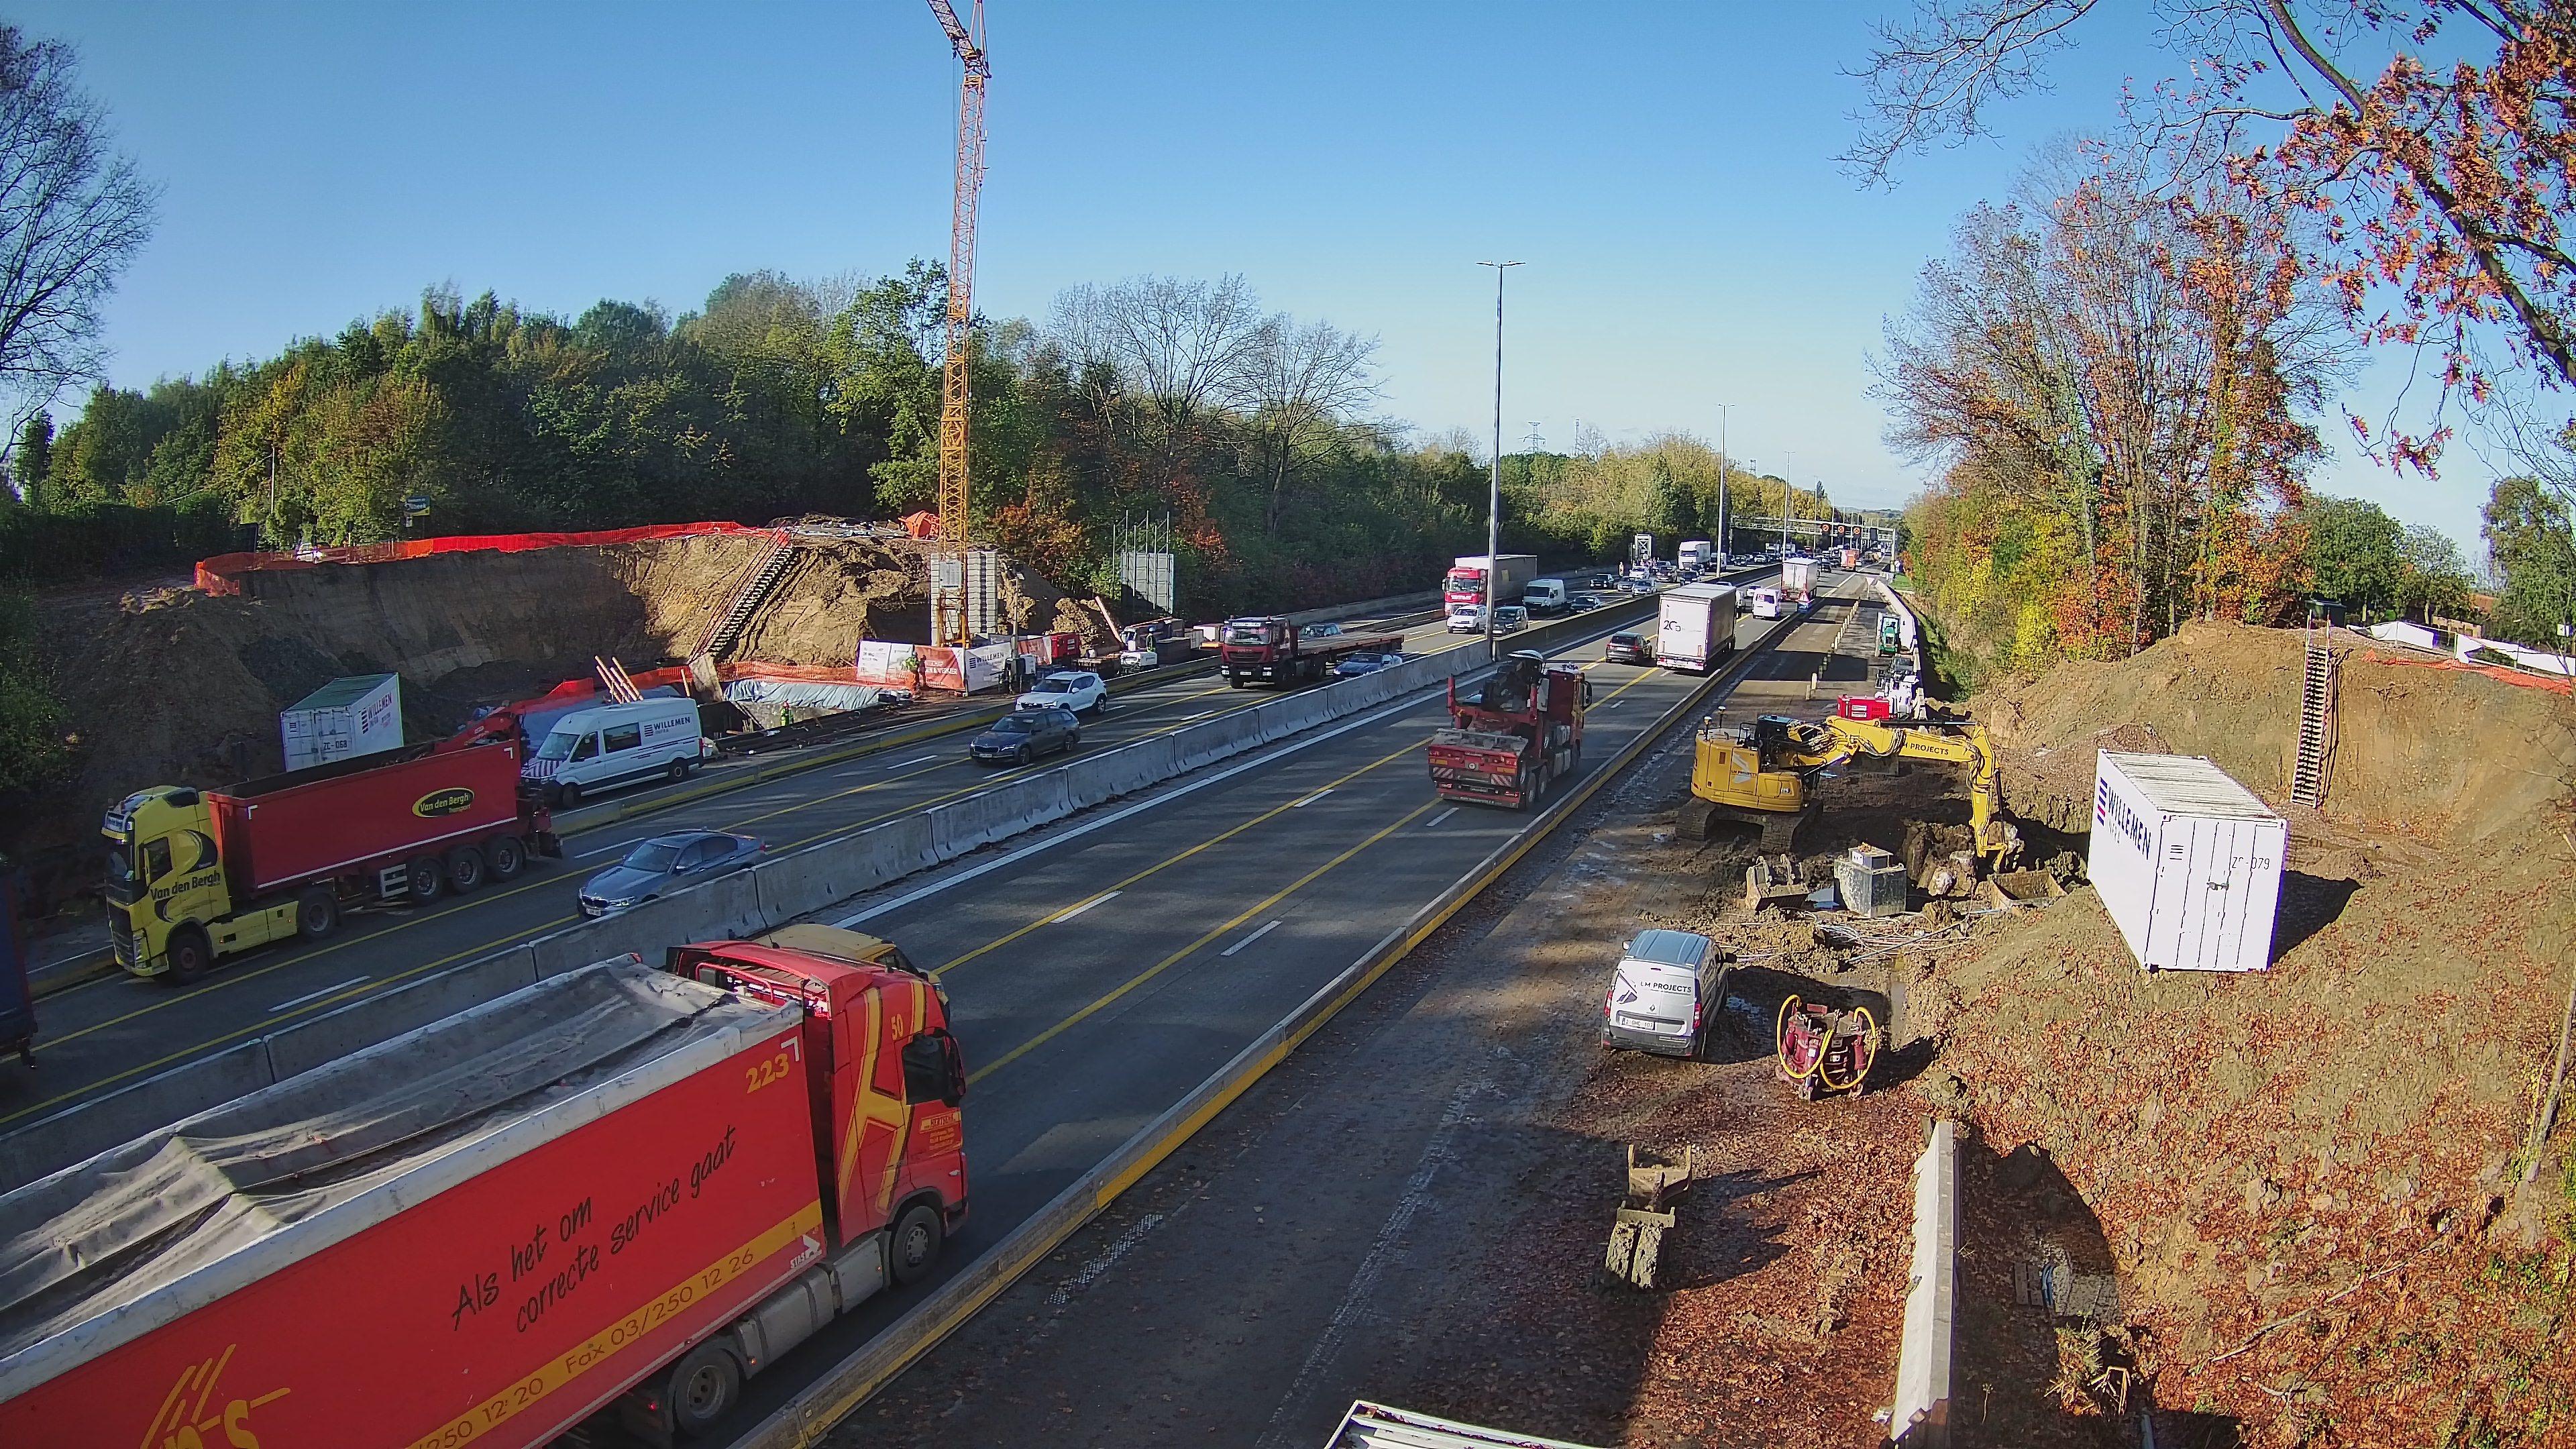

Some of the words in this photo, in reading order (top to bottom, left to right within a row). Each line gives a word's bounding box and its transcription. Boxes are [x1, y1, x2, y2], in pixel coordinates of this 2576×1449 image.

[977, 652, 1004, 663] WILLEMEN
[368, 692, 392, 719] WILLEMEN
[653, 716, 691, 730] WILLEMEN
[1910, 743, 1949, 755] PROJECTS
[420, 803, 433, 812] Van
[434, 799, 448, 808] den
[449, 793, 469, 805] Bergh
[2108, 786, 2151, 861] WILLEMEN
[150, 888, 170, 900] Van
[171, 881, 190, 894] den
[192, 870, 221, 892] Bergh
[1653, 982, 1692, 994] PROJECTS
[891, 1014, 904, 1040] 50
[745, 1053, 790, 1094] 223
[516, 1244, 600, 1333] correcte
[610, 1177, 680, 1255] service
[690, 1124, 736, 1199] gaat
[451, 1272, 499, 1332] Als
[511, 1224, 547, 1282] het
[559, 1197, 592, 1242] om
[514, 1377, 543, 1406] 20
[566, 1344, 606, 1374] Fax
[610, 1285, 694, 1346] 03/250
[702, 1268, 722, 1290] 12
[729, 1247, 754, 1275] 26
